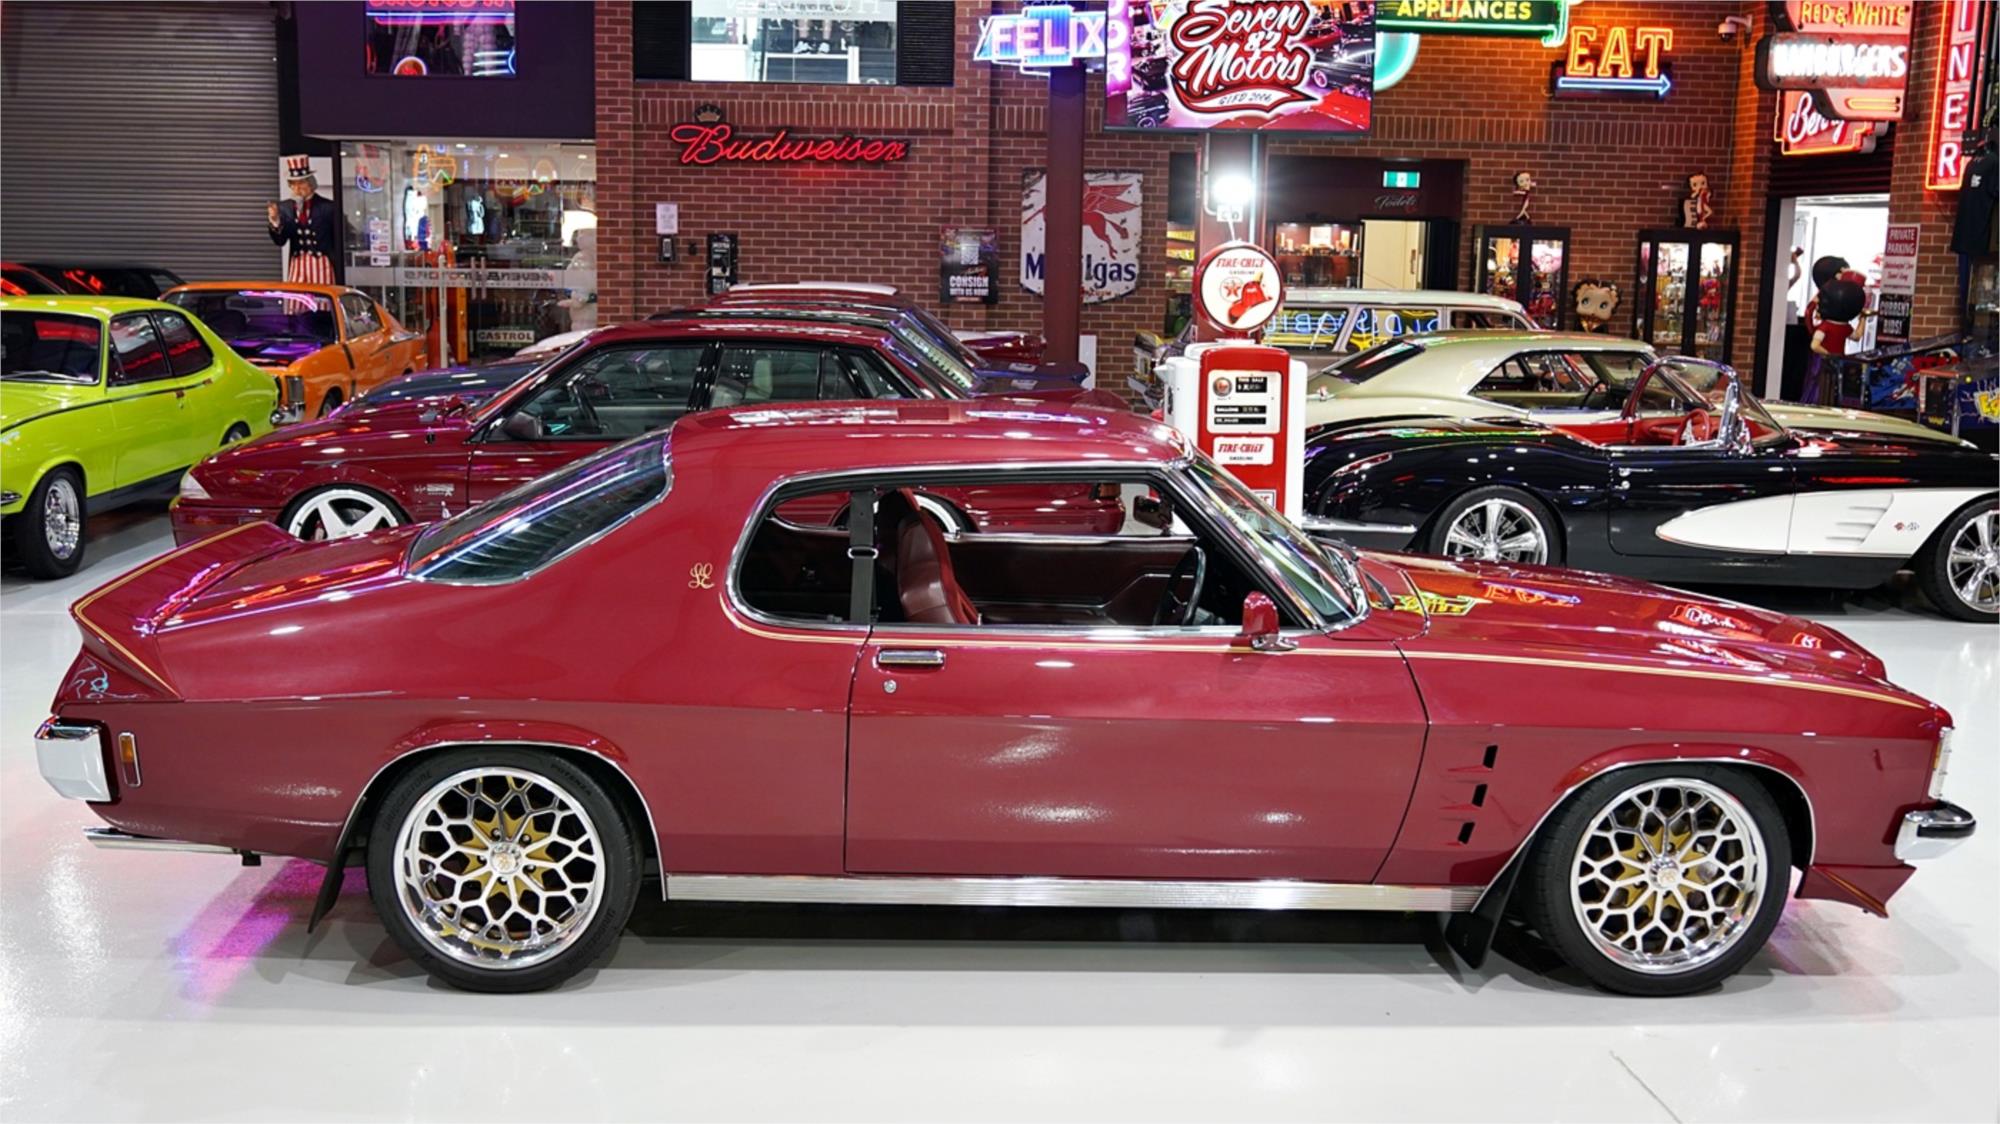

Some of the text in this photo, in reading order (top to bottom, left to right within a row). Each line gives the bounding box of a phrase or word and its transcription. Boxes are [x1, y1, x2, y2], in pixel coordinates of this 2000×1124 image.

[1397, 0, 1532, 20] APPLIANCES
[1801, 1, 1907, 26] RED & WHITE
[1179, 1, 1302, 47] Seven
[991, 17, 1106, 56] FELIX
[1244, 30, 1282, 51] 82
[1564, 27, 1673, 78] EAT
[1773, 43, 1908, 78] HAMBURGERS
[1178, 43, 1304, 93] Motors
[671, 123, 907, 165] Budweiser
[1889, 228, 1916, 241] PRIVATE
[1886, 242, 1916, 255] PARKING
[949, 275, 989, 288] CONSIGN
[1880, 301, 1910, 317] CURRENT
[478, 331, 533, 341] CASTROL
[1883, 319, 1903, 335] BIDS!
